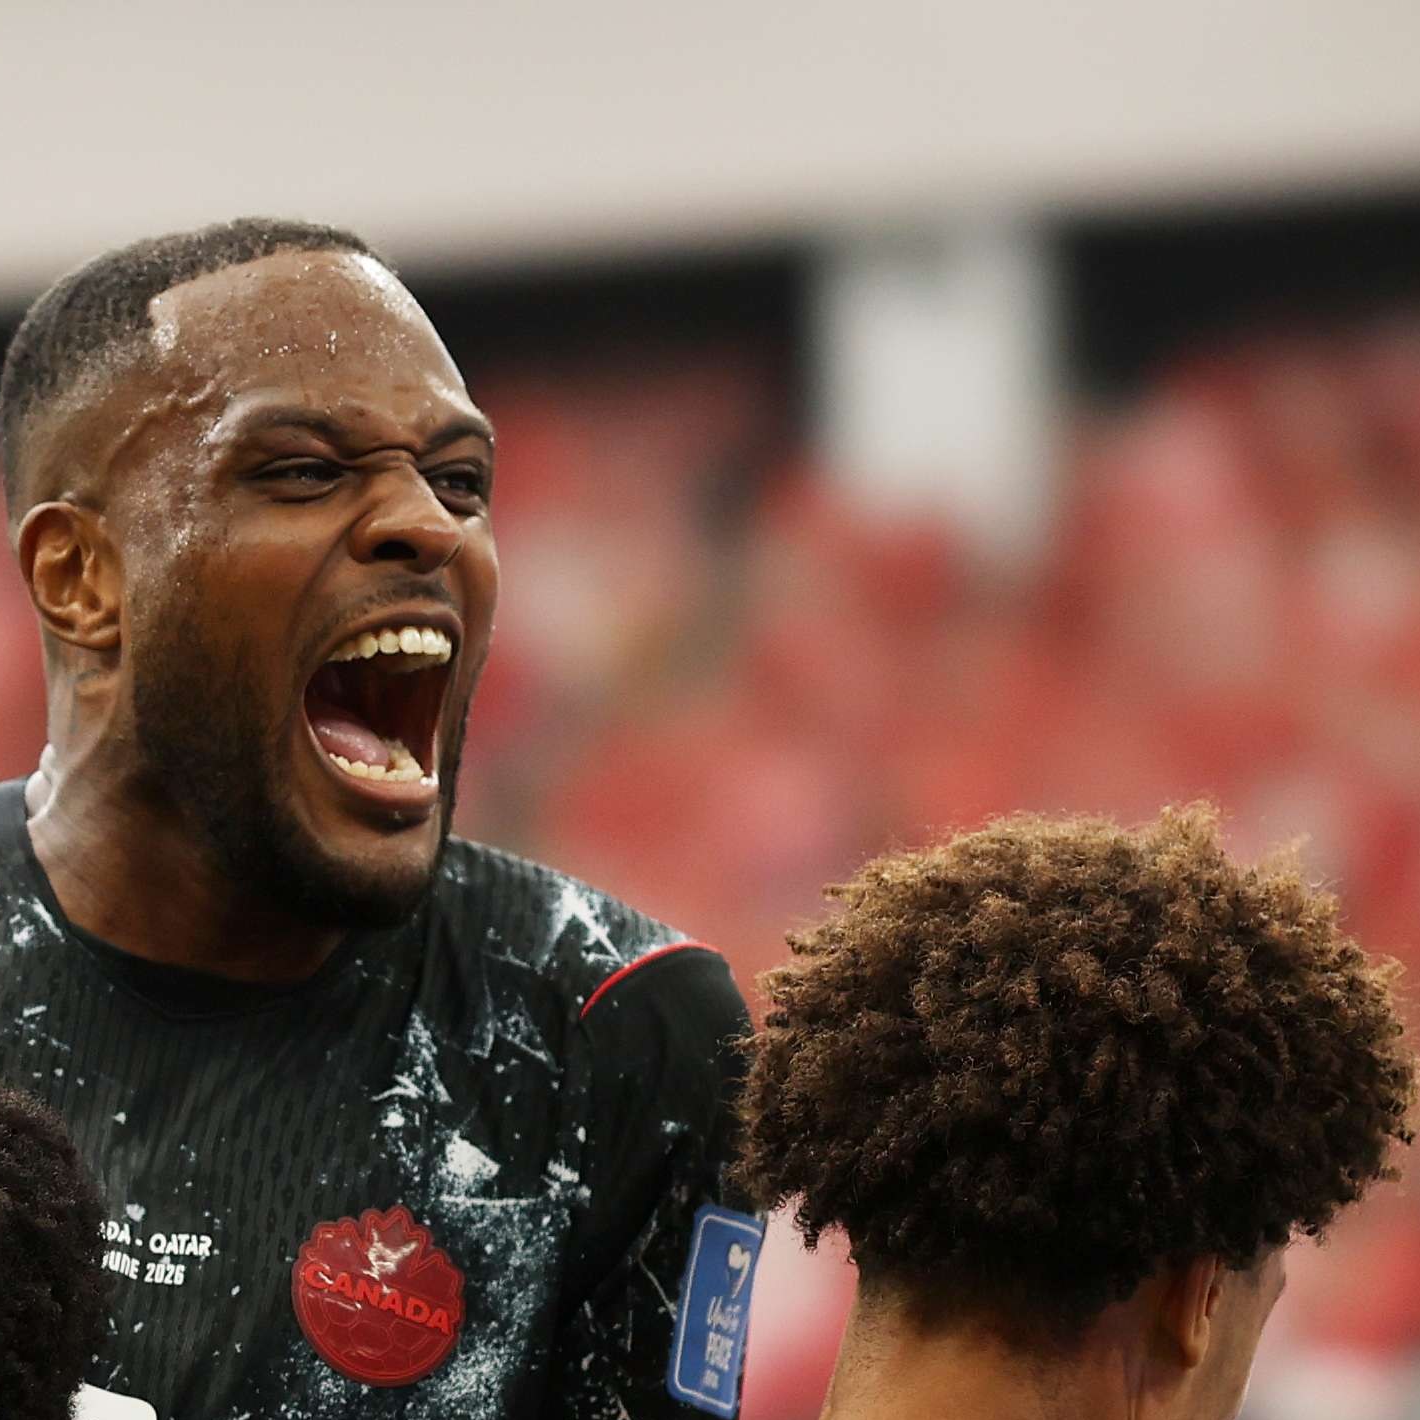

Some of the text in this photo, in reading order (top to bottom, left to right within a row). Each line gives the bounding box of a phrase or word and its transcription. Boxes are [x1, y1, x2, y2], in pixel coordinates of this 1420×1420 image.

[149, 1232, 213, 1257] QATAR
[144, 1262, 186, 1286] 2026
[304, 1263, 450, 1336] CANADA
